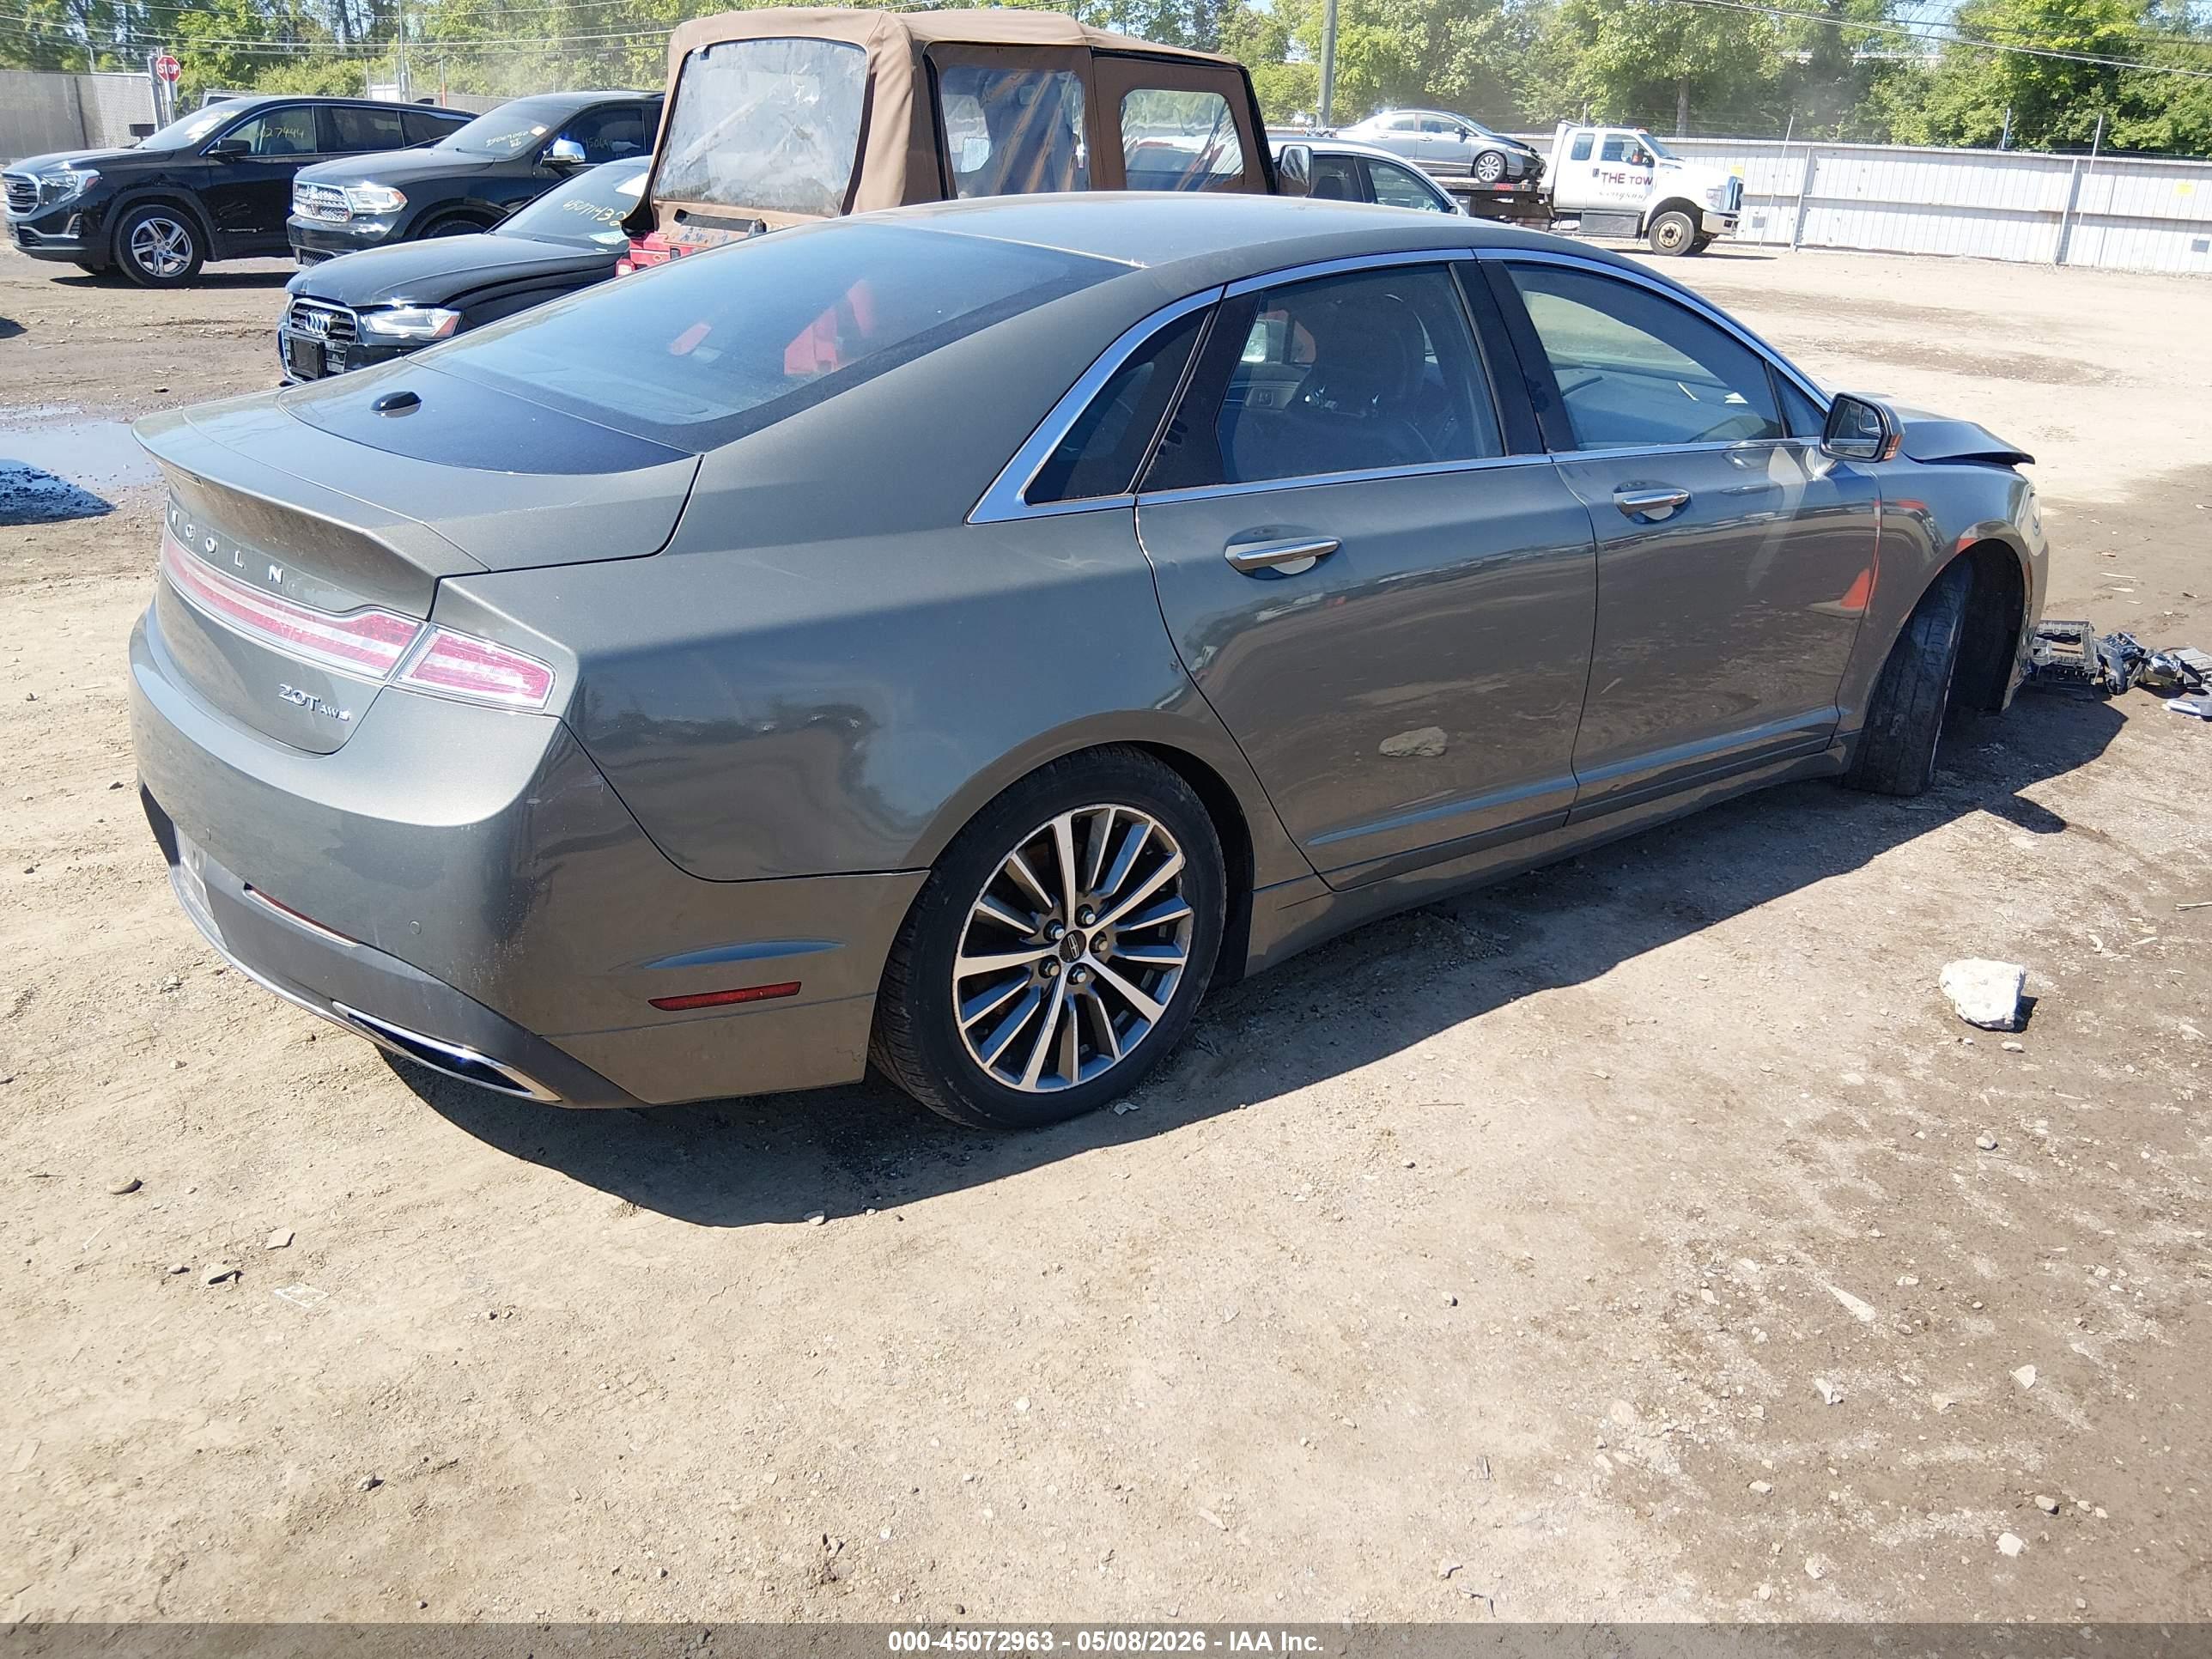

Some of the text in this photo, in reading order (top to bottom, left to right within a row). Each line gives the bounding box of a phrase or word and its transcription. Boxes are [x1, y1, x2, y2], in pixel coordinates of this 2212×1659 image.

[158, 63, 179, 75] STOP
[1601, 172, 1654, 186] THE TOW
